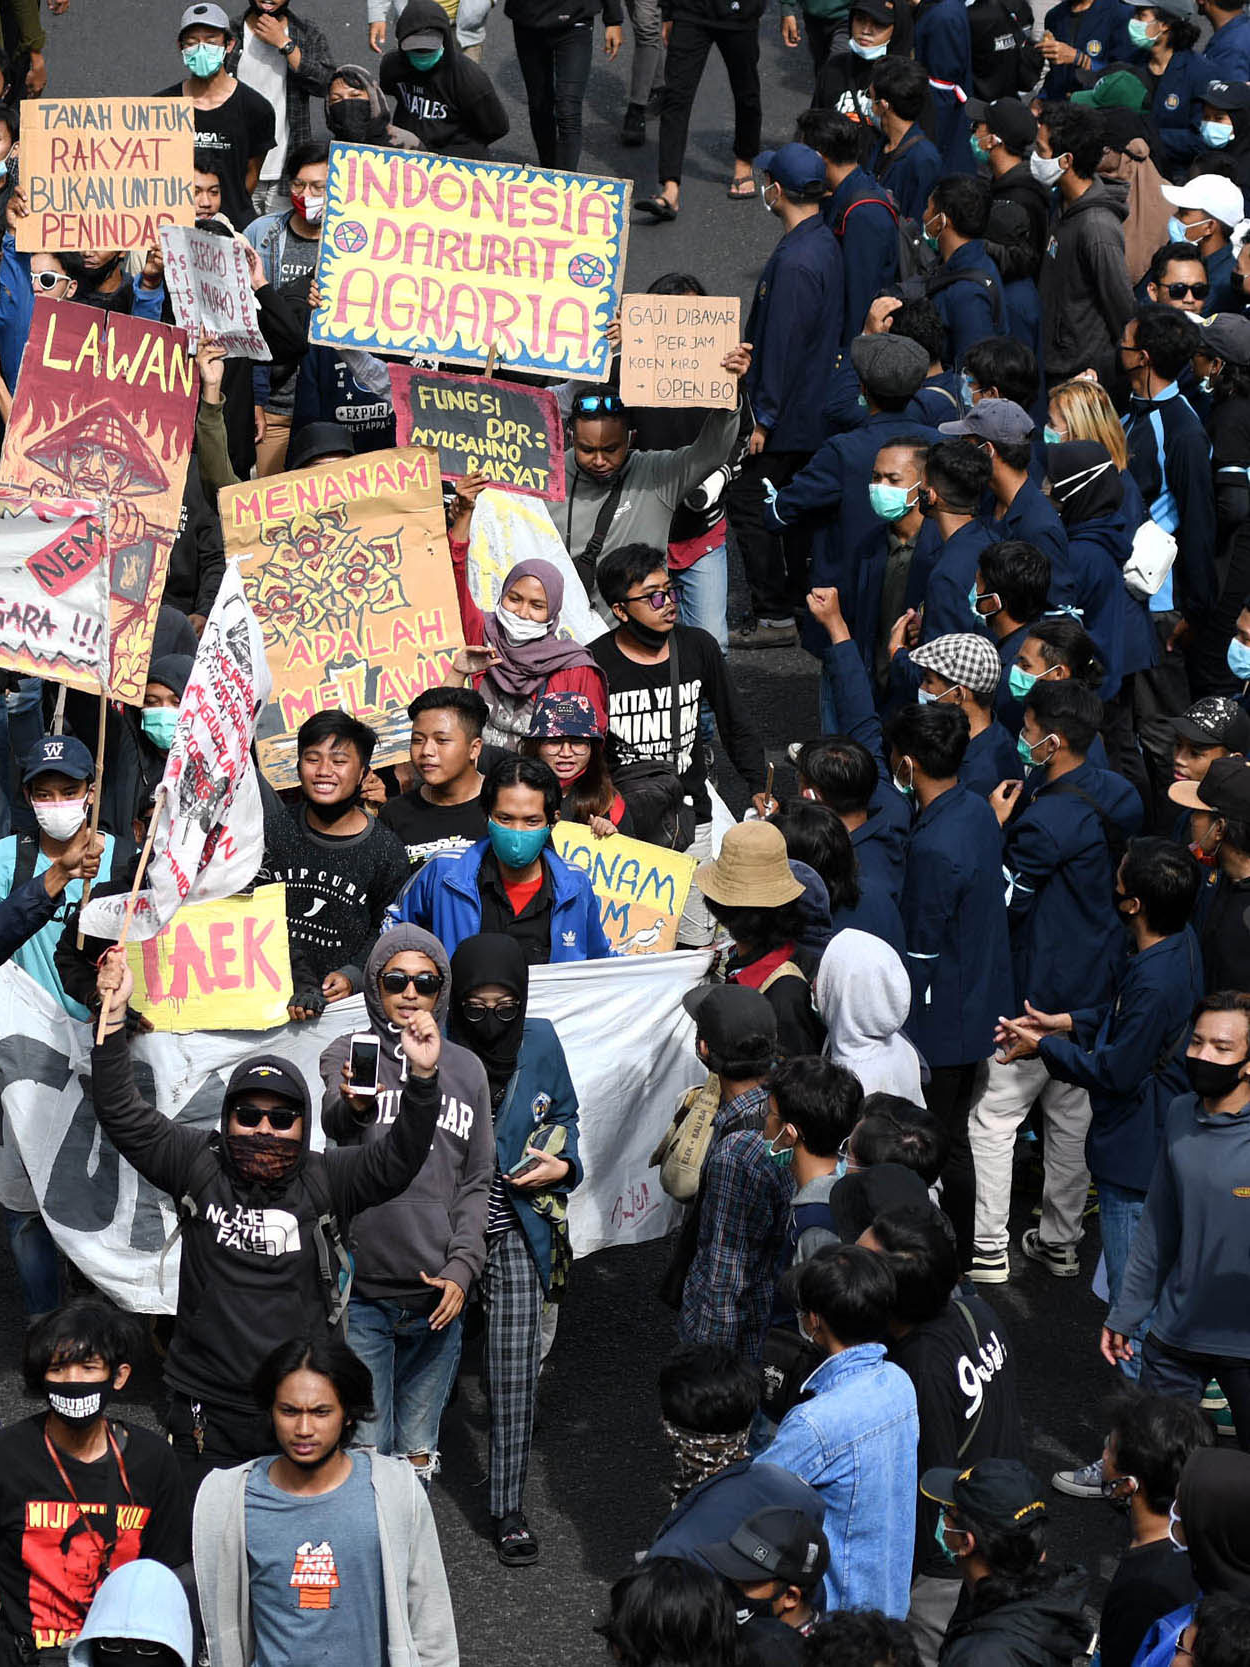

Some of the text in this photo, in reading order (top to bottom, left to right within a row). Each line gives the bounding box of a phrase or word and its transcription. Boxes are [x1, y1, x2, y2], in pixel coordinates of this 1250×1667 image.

[38, 103, 195, 133] TANAH UNTUK
[51, 137, 171, 174] RAKYAT
[30, 175, 195, 213] BUKAN UNTUK
[344, 156, 612, 236] INDONESIA
[370, 217, 574, 284] DARURAT
[332, 267, 590, 359] AGRARIA
[629, 305, 736, 326] GAJI DIBAYAR
[42, 313, 193, 398] LAWAN
[656, 334, 715, 350] PER JAM
[629, 357, 700, 370] KOEN KIRO
[417, 385, 501, 416] FUNGSI
[655, 377, 735, 400] OPEN BO
[411, 427, 522, 463] NYUSAHNO
[466, 455, 549, 491] RAKYAT
[233, 455, 430, 527] MENANAM
[286, 609, 446, 670] ADALAH
[610, 689, 651, 716] KITA
[318, 870, 367, 905] CURL
[235, 1204, 264, 1225] THE
[216, 1228, 267, 1256] FACE
[28, 1503, 69, 1529] WIJI
